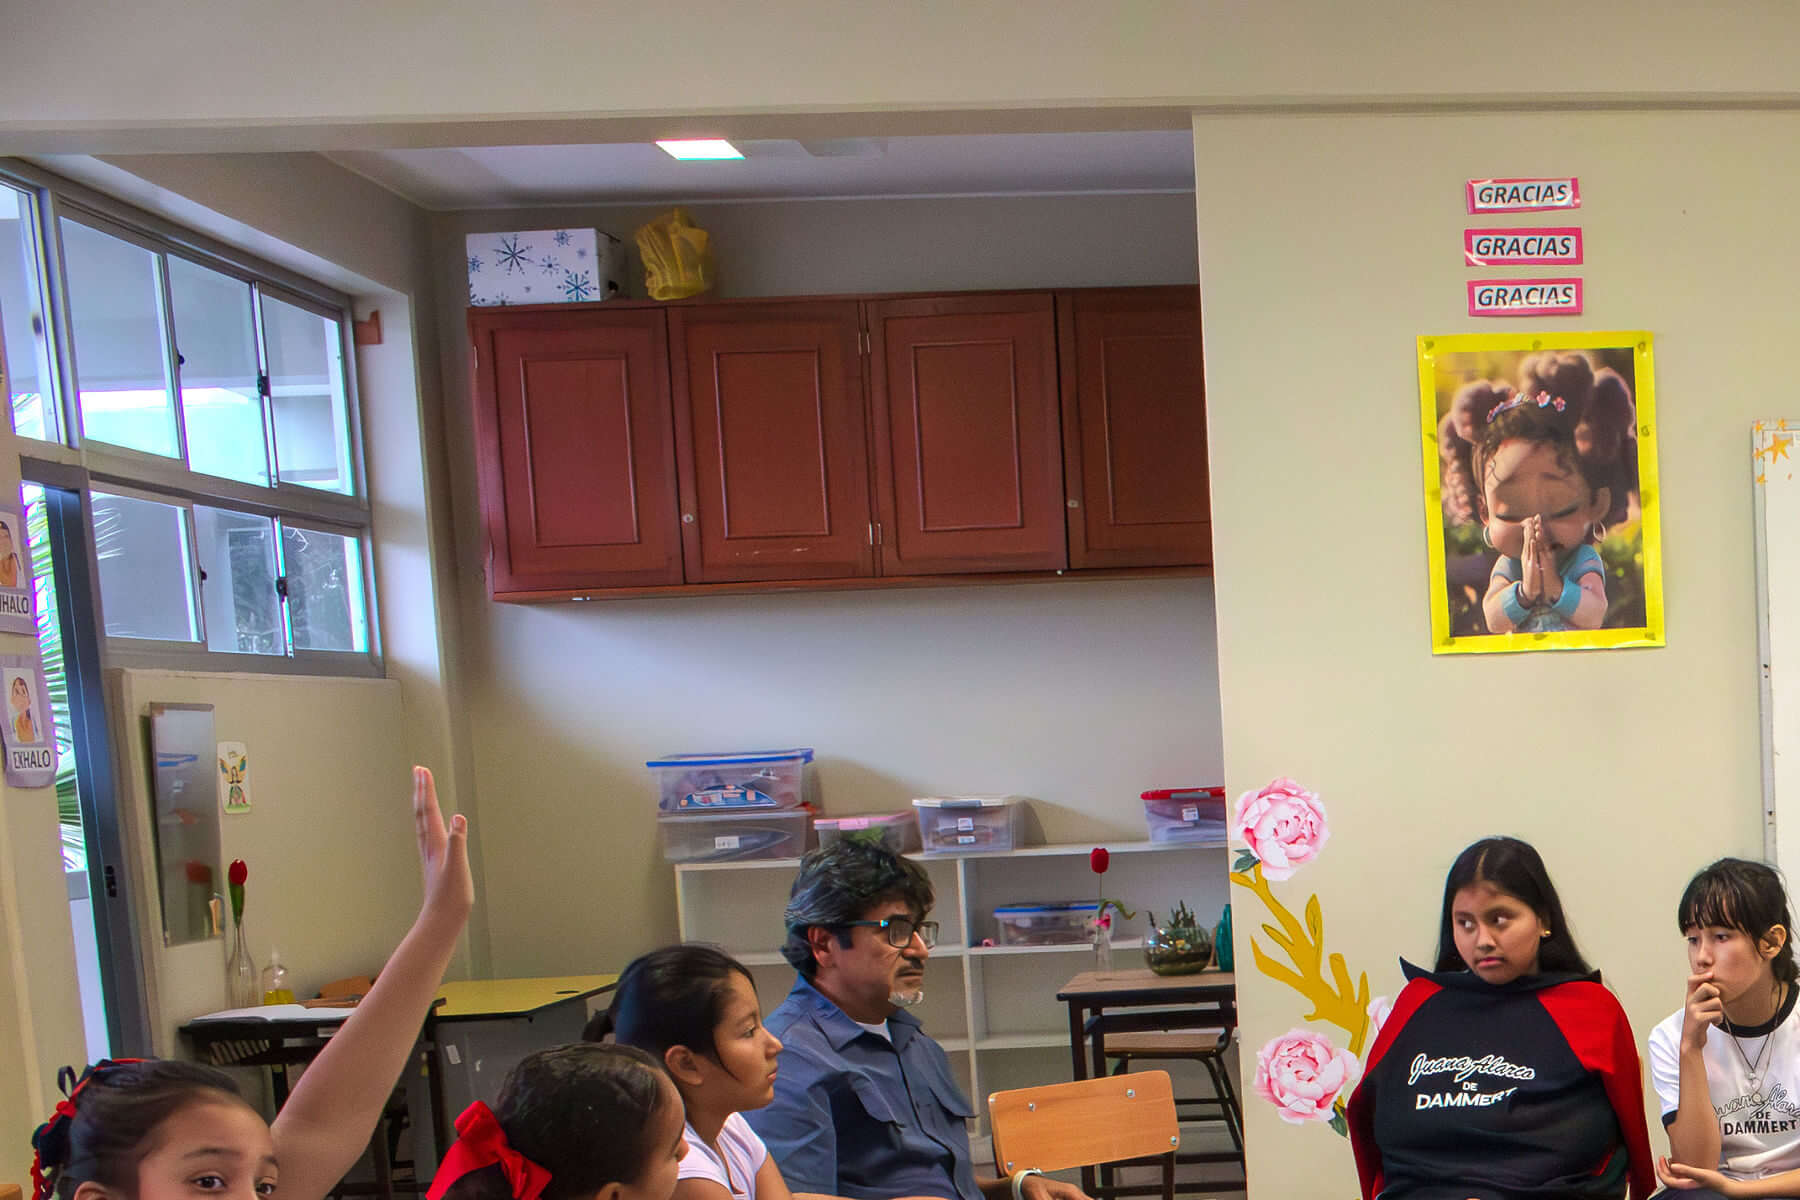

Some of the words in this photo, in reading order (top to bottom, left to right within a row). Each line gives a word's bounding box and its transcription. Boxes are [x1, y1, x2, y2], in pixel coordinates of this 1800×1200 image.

[1479, 184, 1568, 204] GRACIAS
[1476, 237, 1571, 256] GRACIAS
[1478, 286, 1573, 306] GRACIAS
[0, 594, 29, 614] HALO
[14, 749, 51, 769] EXHALO
[1407, 1053, 1472, 1085] Juana
[1453, 1054, 1536, 1083] Alarco
[1462, 1081, 1478, 1091] DE
[1415, 1086, 1518, 1110] DAMMERT
[1756, 1111, 1771, 1120] DE
[1724, 1119, 1797, 1135] DAMMERT
